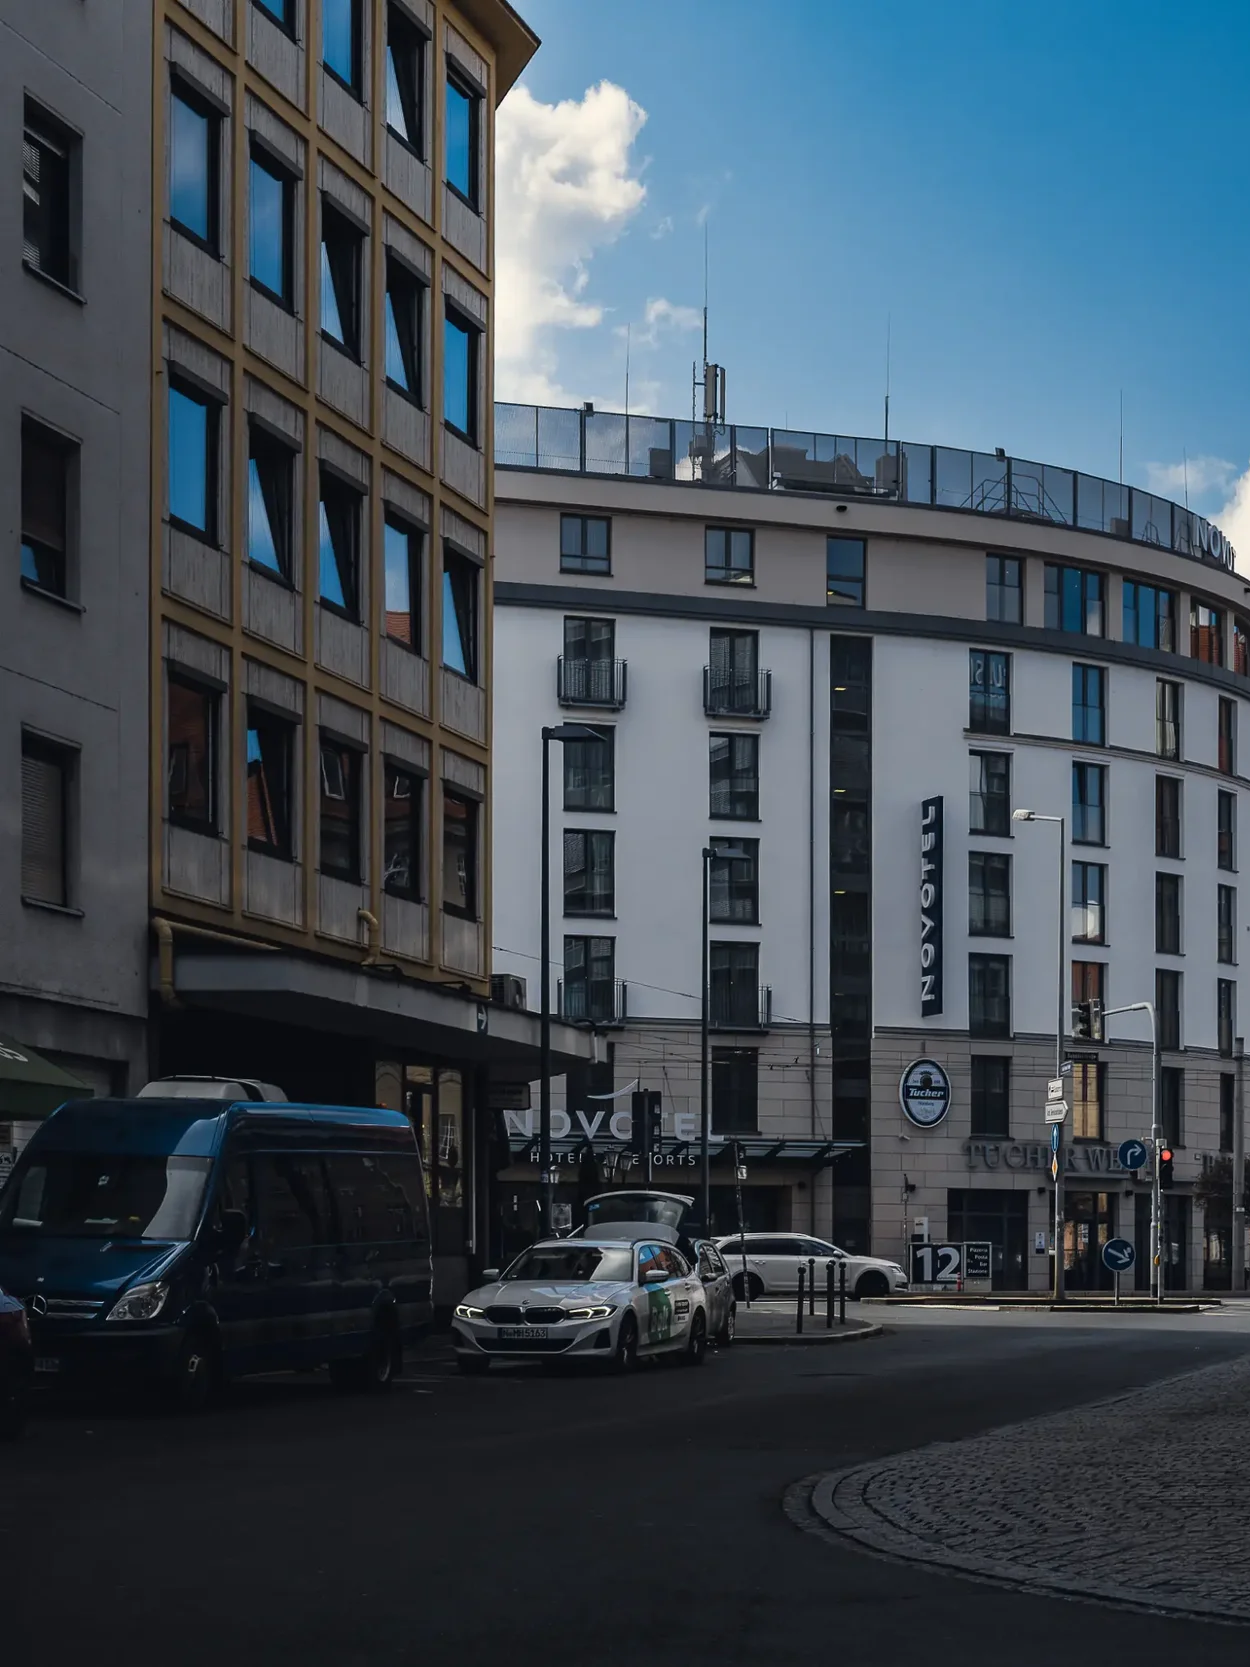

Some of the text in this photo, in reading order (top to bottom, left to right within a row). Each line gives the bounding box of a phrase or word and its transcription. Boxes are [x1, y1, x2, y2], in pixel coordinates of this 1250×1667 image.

[921, 805, 936, 1001] NOVOTEL
[909, 1088, 944, 1098] Tucher
[503, 1109, 724, 1142] NOVOEL
[916, 1247, 960, 1281] 12
